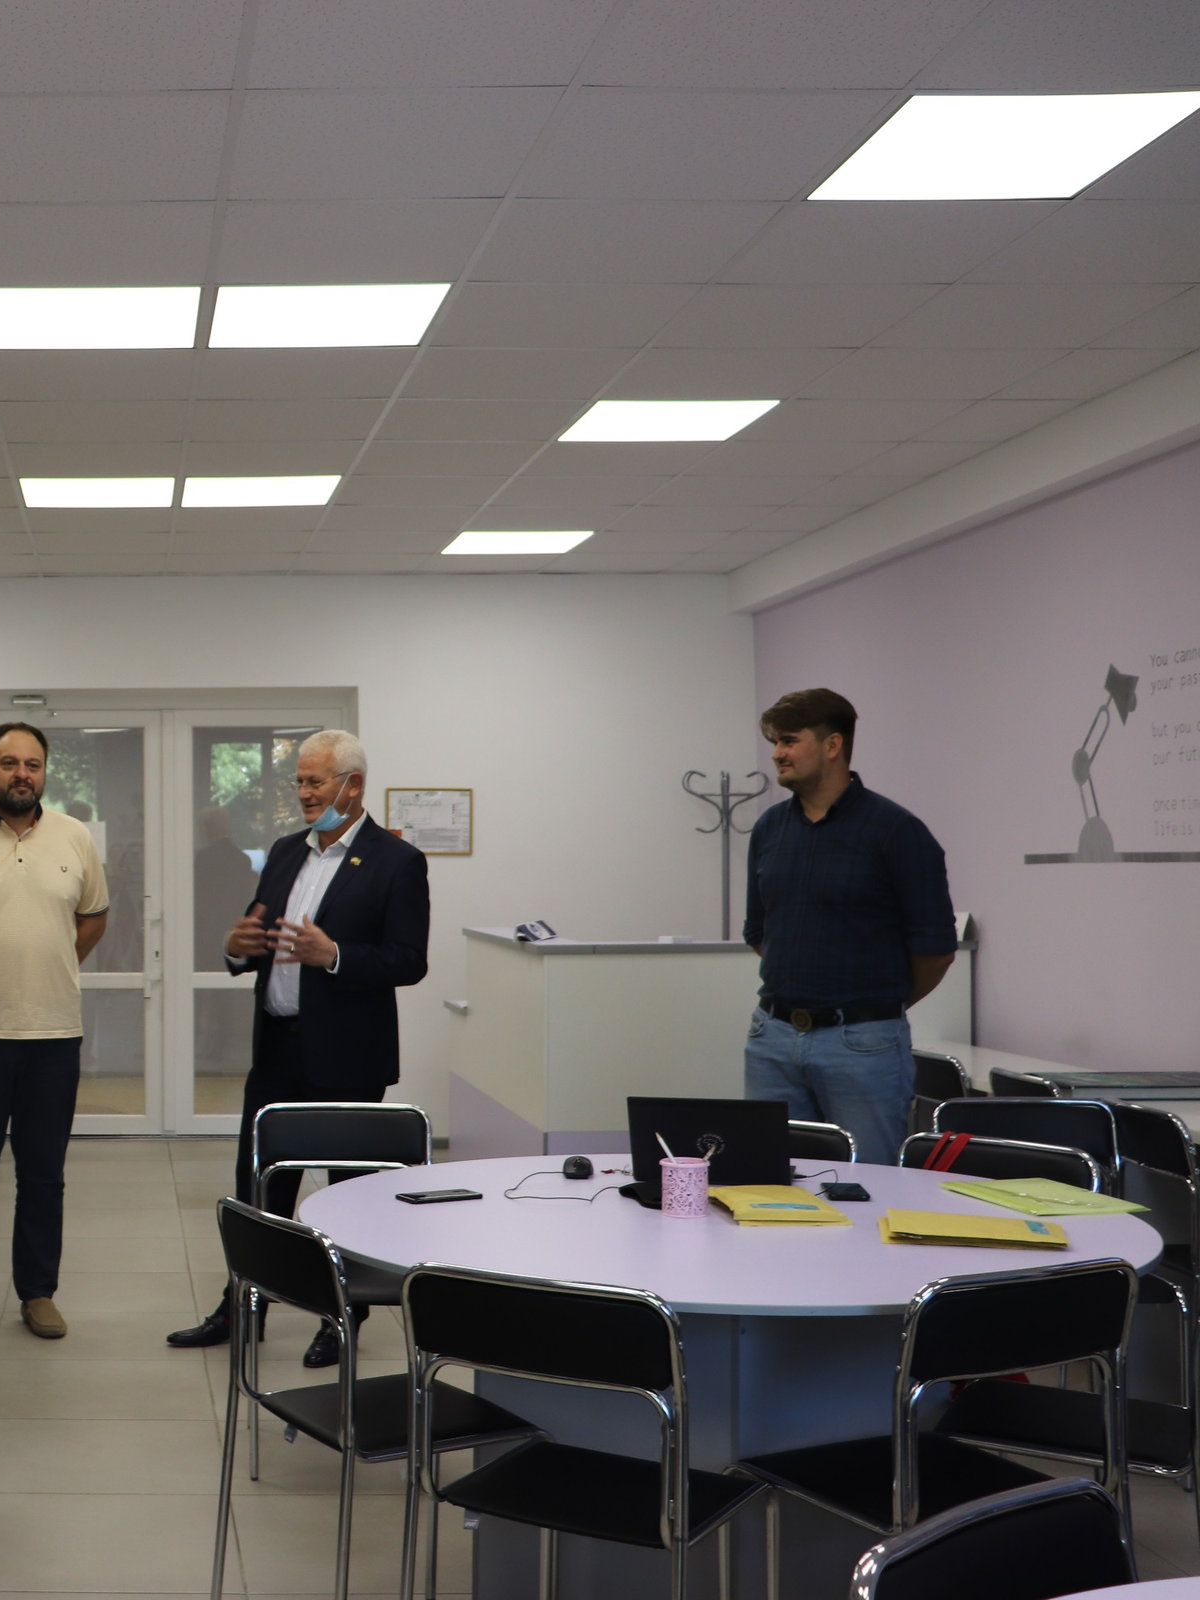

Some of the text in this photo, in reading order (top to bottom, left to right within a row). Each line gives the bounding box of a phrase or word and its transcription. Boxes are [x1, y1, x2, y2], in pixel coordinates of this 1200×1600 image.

[1150, 654, 1169, 668] You
[1150, 672, 1200, 696] your pas
[1152, 722, 1169, 738] but
[1174, 723, 1192, 739] you
[1152, 745, 1200, 766] our fut
